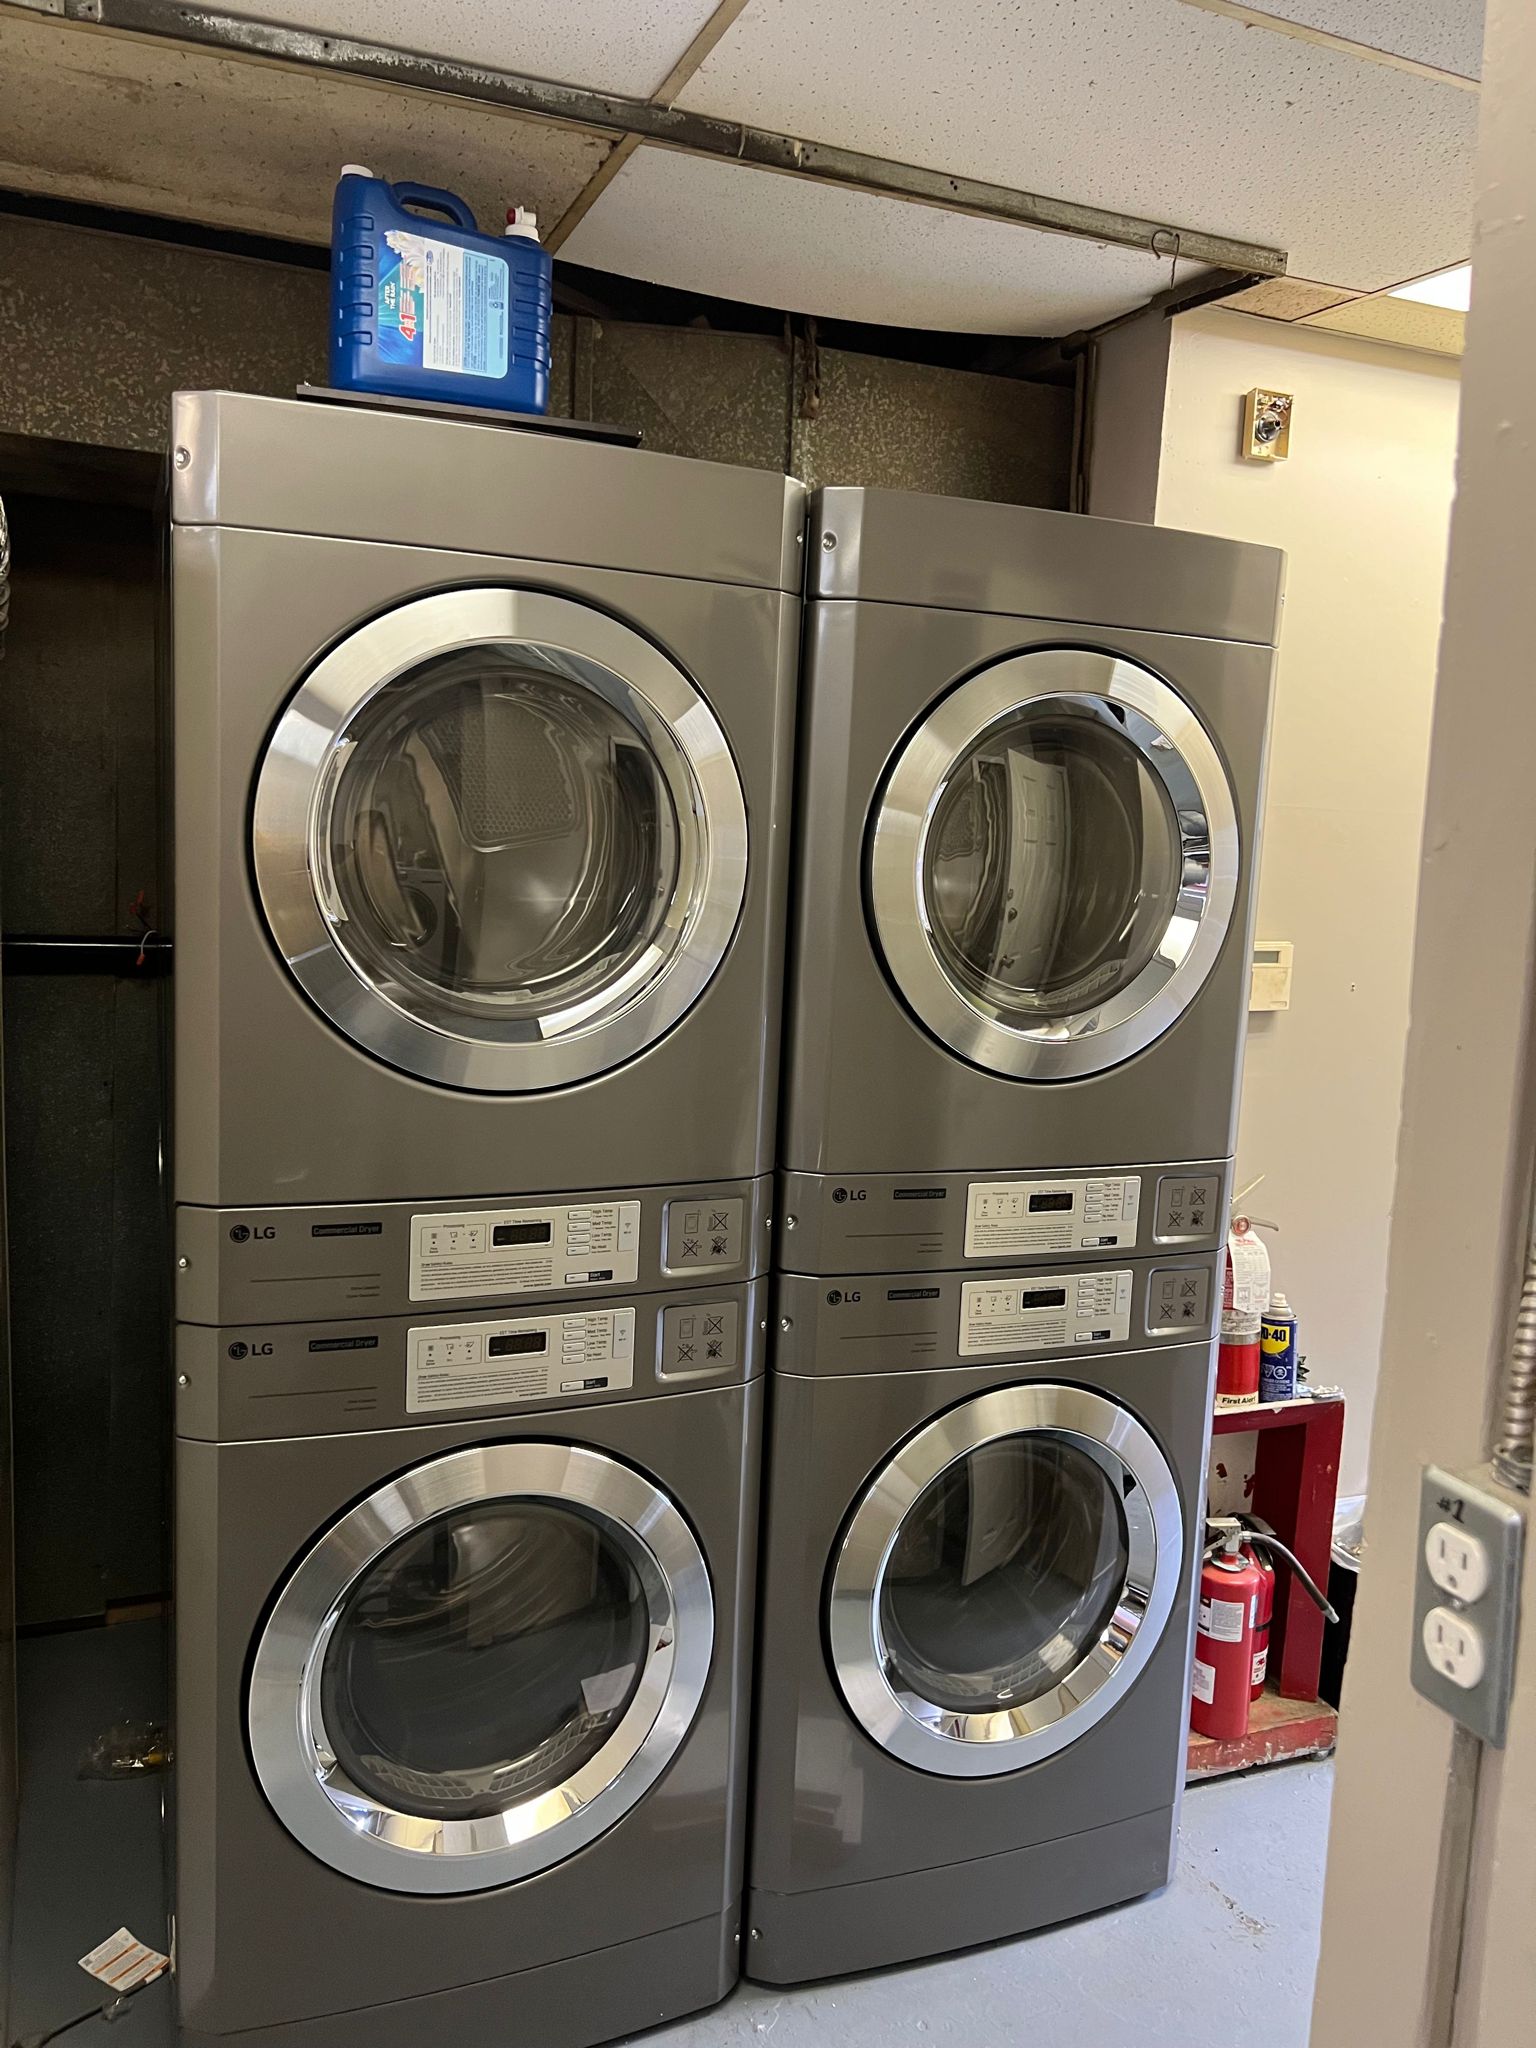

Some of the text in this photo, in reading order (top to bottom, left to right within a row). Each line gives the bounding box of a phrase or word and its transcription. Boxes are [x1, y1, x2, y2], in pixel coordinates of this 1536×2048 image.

[850, 1190, 867, 1200] LG
[254, 1224, 380, 1239] LG Commercial Dryer
[844, 1291, 861, 1303] LG
[1261, 1326, 1287, 1342] D-40
[252, 1338, 376, 1356] LG Commercial Dryer
